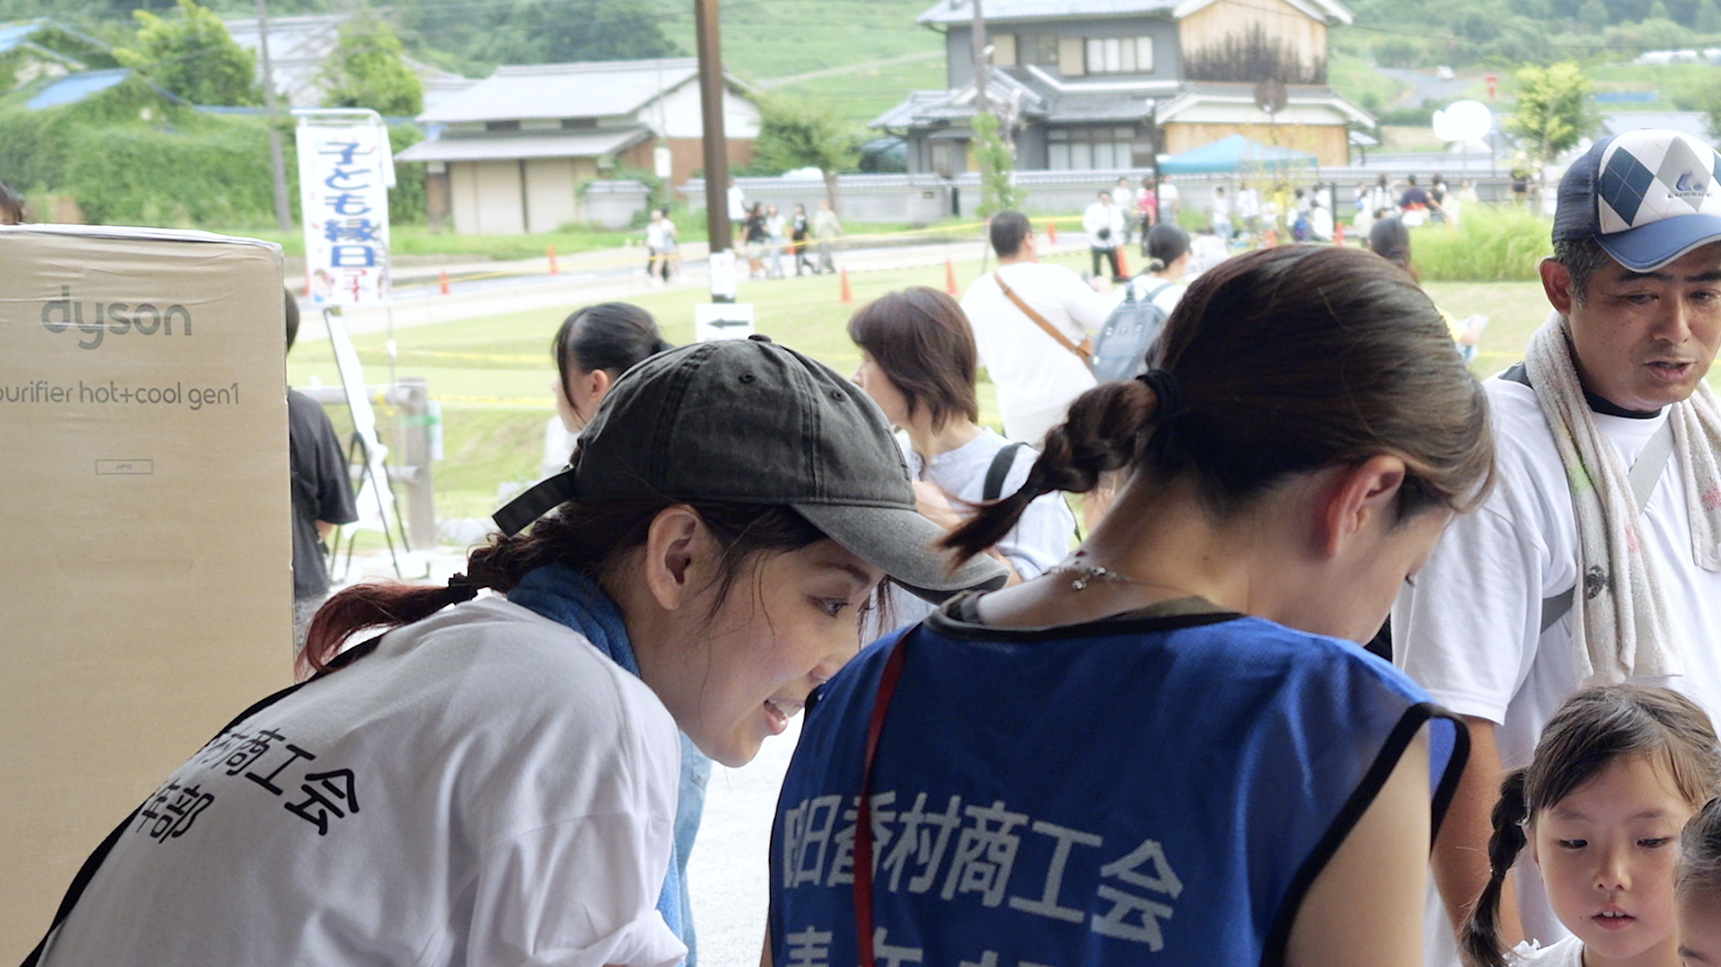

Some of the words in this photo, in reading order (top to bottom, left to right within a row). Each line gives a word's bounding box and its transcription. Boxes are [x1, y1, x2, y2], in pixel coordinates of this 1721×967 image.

[318, 141, 381, 268] 子ども縁日
[41, 284, 193, 351] dyson
[79, 381, 182, 405] hot+cool
[187, 382, 240, 411] gen1
